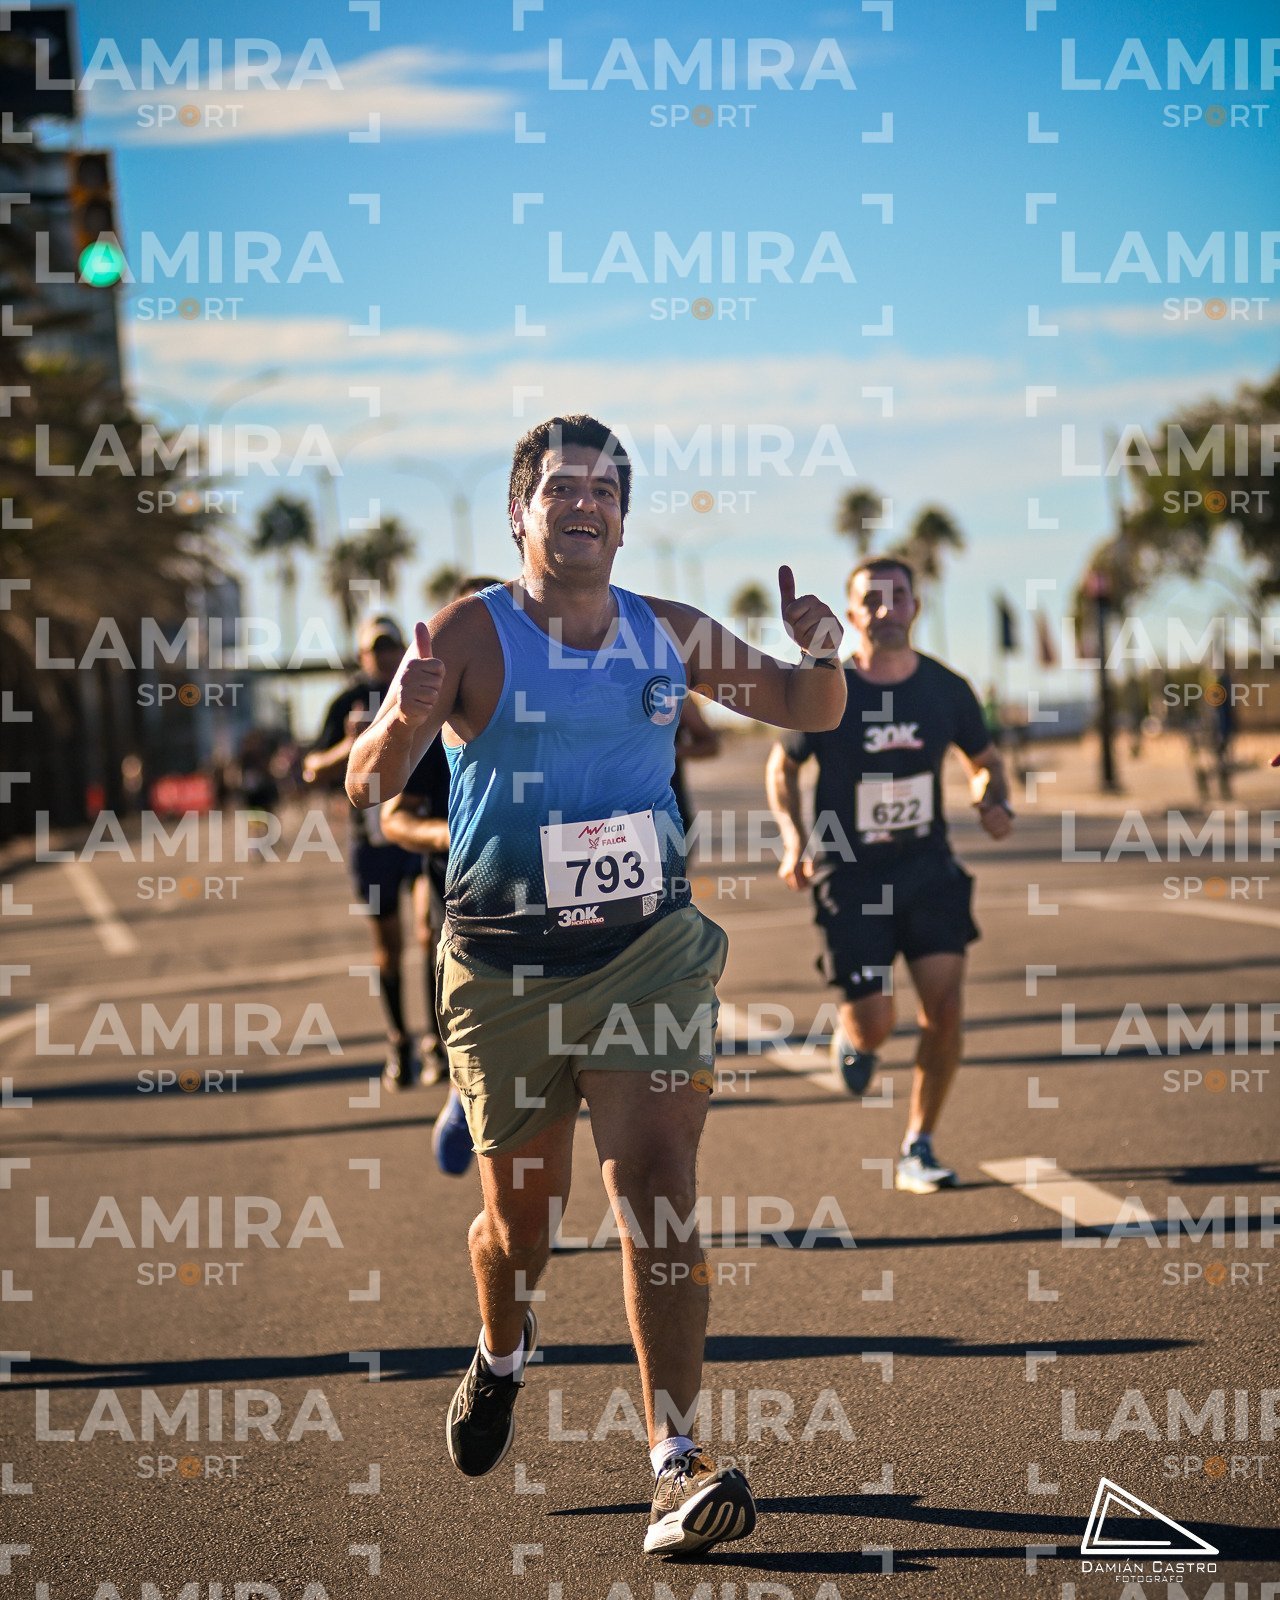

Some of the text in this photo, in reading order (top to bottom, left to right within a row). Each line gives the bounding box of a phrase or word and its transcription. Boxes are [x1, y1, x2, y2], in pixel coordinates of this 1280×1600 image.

[872, 799, 921, 824] 622
[604, 823, 626, 834] ucm
[601, 835, 628, 847] FALCK
[566, 850, 645, 898] 793
[557, 905, 600, 928] 30K
